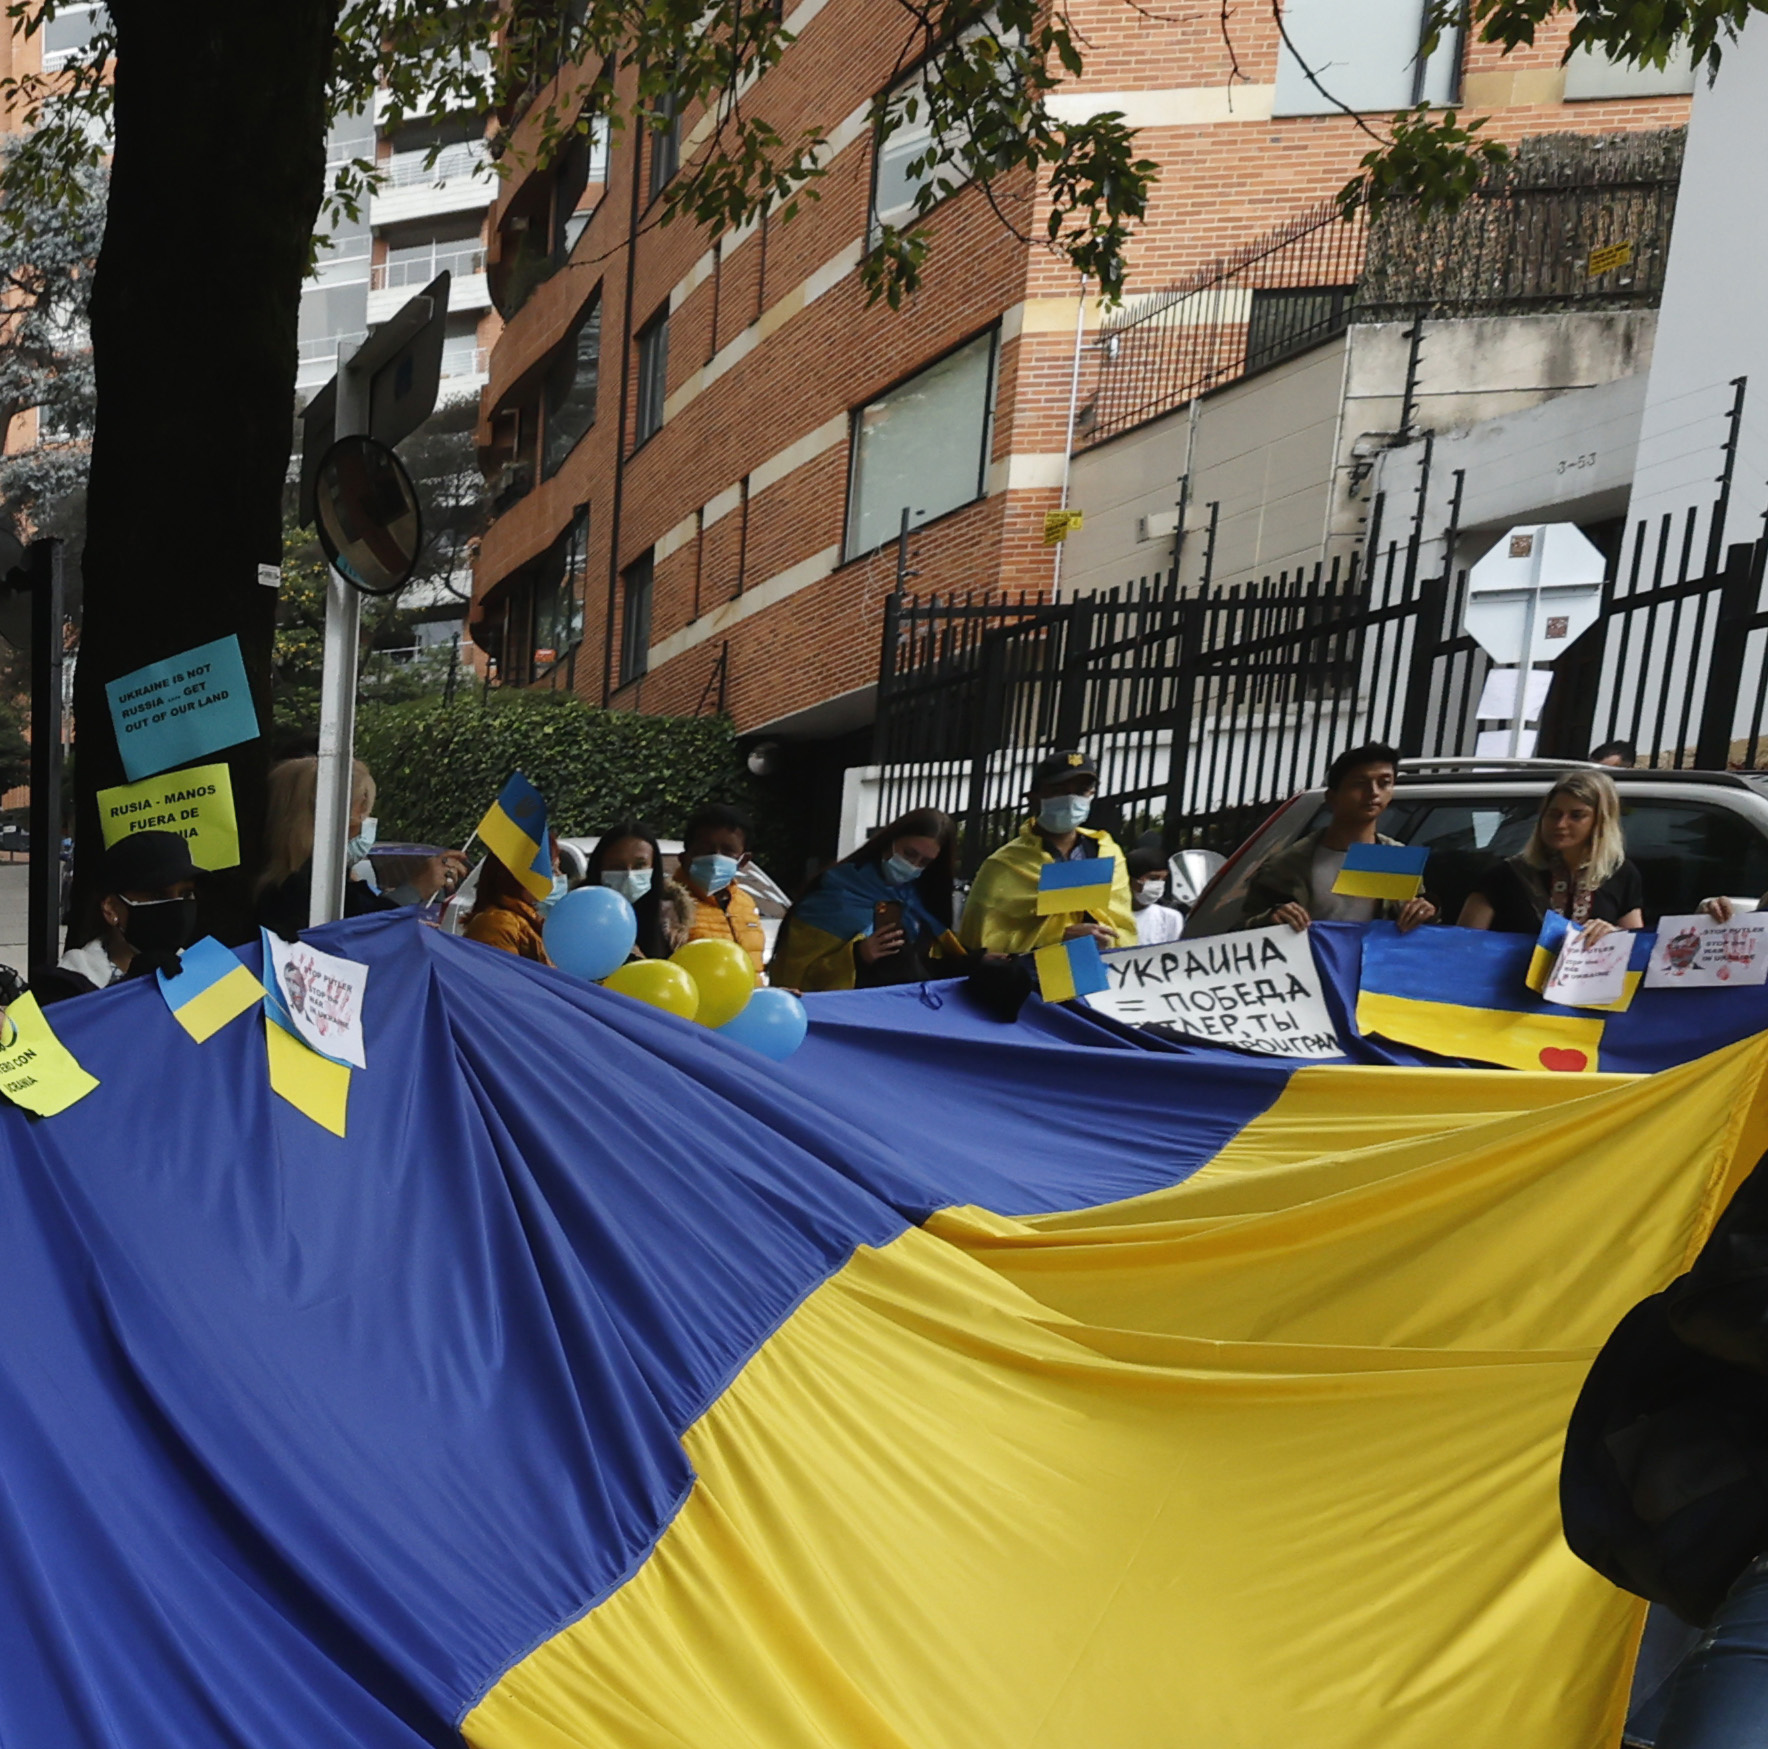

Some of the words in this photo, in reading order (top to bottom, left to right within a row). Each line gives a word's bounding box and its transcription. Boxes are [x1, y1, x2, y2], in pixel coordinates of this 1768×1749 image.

[118, 678, 170, 704] UKRAINE
[172, 673, 184, 685] IS
[187, 663, 212, 679] NOT
[122, 696, 165, 719] RUSSIA
[183, 681, 207, 697] GET
[125, 718, 148, 733] OUT
[151, 711, 168, 724] OF
[170, 702, 196, 718] OUR
[198, 690, 230, 709] LAND
[110, 799, 153, 818] RUSIA
[164, 784, 217, 805] MANOS
[129, 813, 176, 832] FUERA
[180, 807, 200, 820] DE
[304, 966, 322, 979] STOP
[1109, 936, 1287, 989] УКРАИНА
[308, 986, 326, 998] STOP
[309, 996, 324, 1009] WAR
[1161, 972, 1312, 1013] ПОБЕДА
[1249, 1011, 1299, 1033] ТЫ
[13, 1048, 37, 1067] CON
